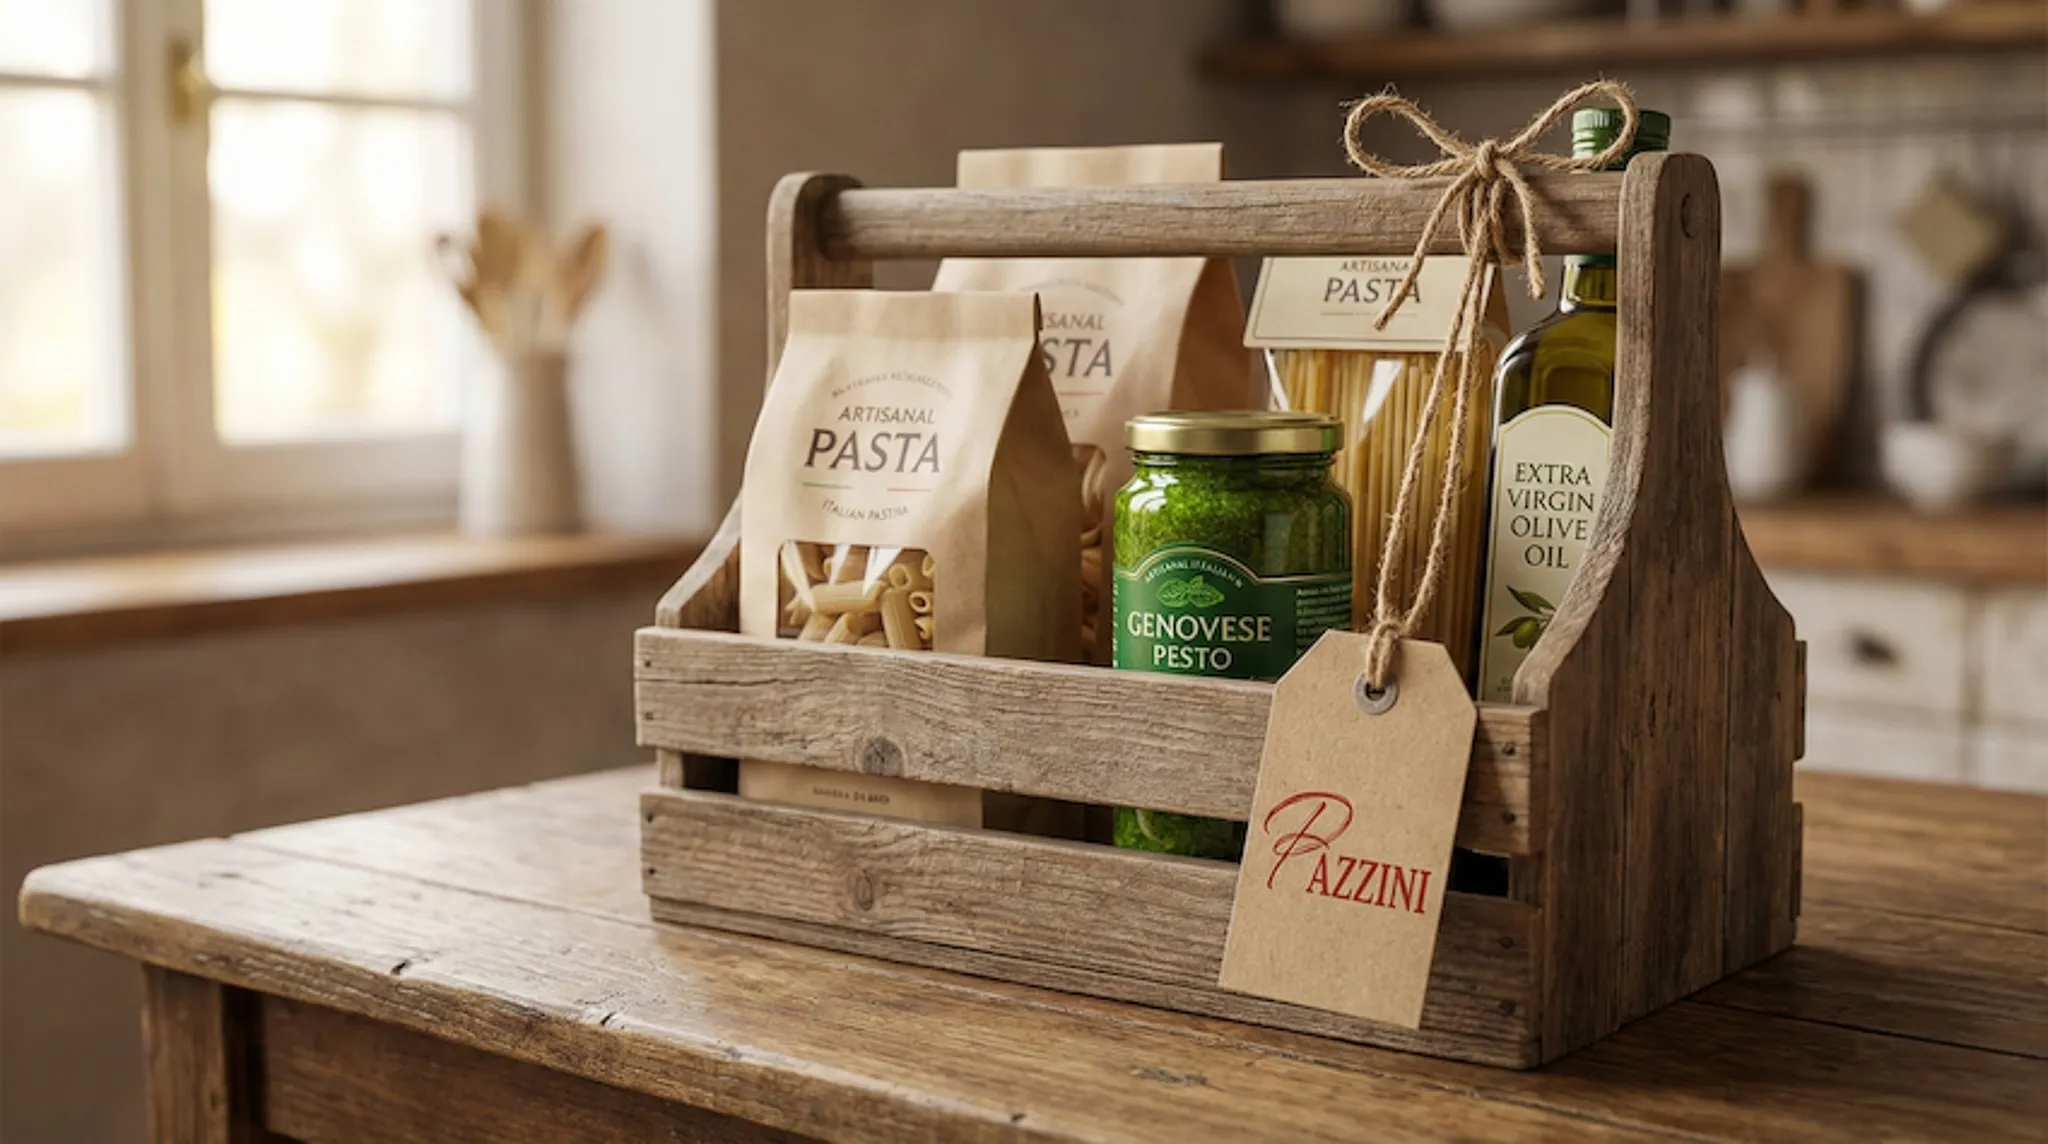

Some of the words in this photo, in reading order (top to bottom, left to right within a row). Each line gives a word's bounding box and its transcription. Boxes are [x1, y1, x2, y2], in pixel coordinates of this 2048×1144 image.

[1341, 259, 1410, 272] ARTISANA
[1323, 276, 1421, 304] PASTA
[1044, 312, 1106, 331] SANAL
[1042, 337, 1113, 378] STA
[838, 405, 936, 425] ARTISANAL
[804, 428, 941, 473] PASTA
[1515, 462, 1592, 486] EXTRA
[1507, 488, 1595, 513] VIRGIN
[1510, 514, 1588, 541] OLIVE
[1524, 543, 1570, 569] OIL
[1127, 610, 1273, 642] GENOVESE
[1153, 644, 1233, 671] PESTO
[1263, 791, 1433, 915] PAZZINI
